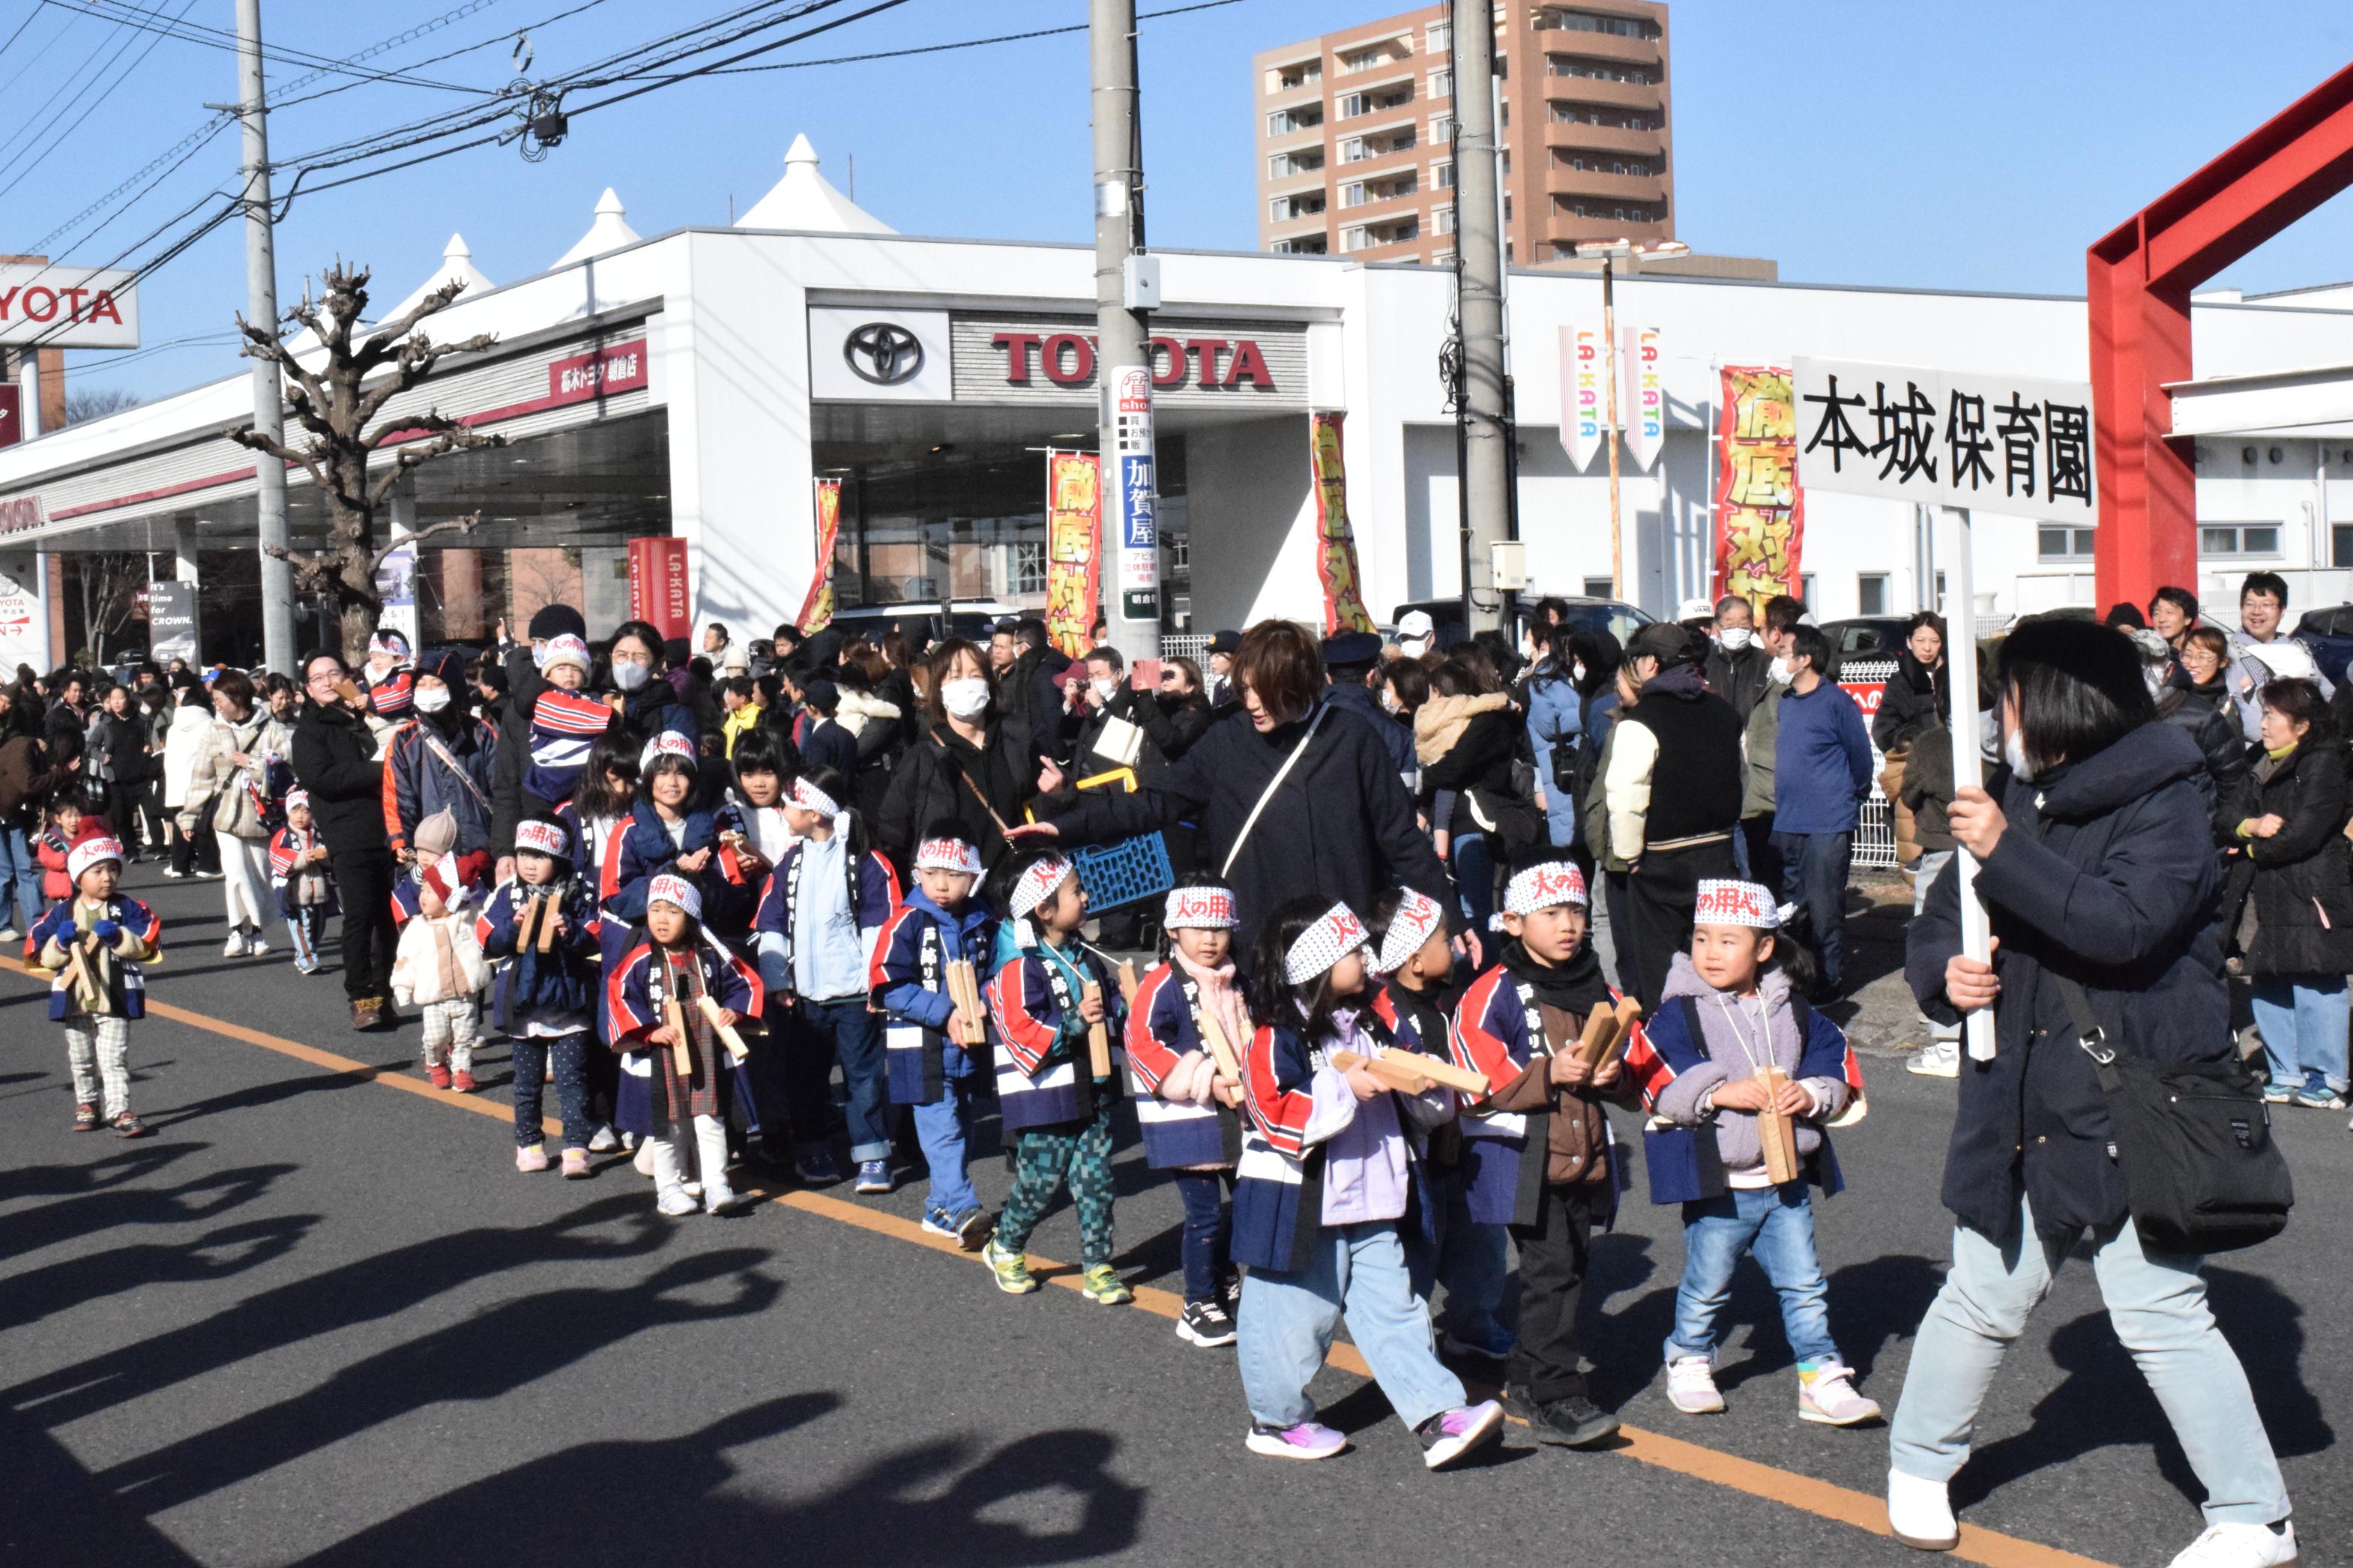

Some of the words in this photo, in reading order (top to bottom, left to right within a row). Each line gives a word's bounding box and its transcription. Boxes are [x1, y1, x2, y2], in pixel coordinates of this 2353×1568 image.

[992, 332, 1274, 387] TOOTA
[1124, 376, 1150, 399] 質
[1803, 374, 2093, 507] 本城保育園
[1127, 459, 1154, 545] 加賀屋
[151, 606, 166, 615] for
[152, 615, 193, 625] CROWN.
[1696, 887, 1760, 917] の用心
